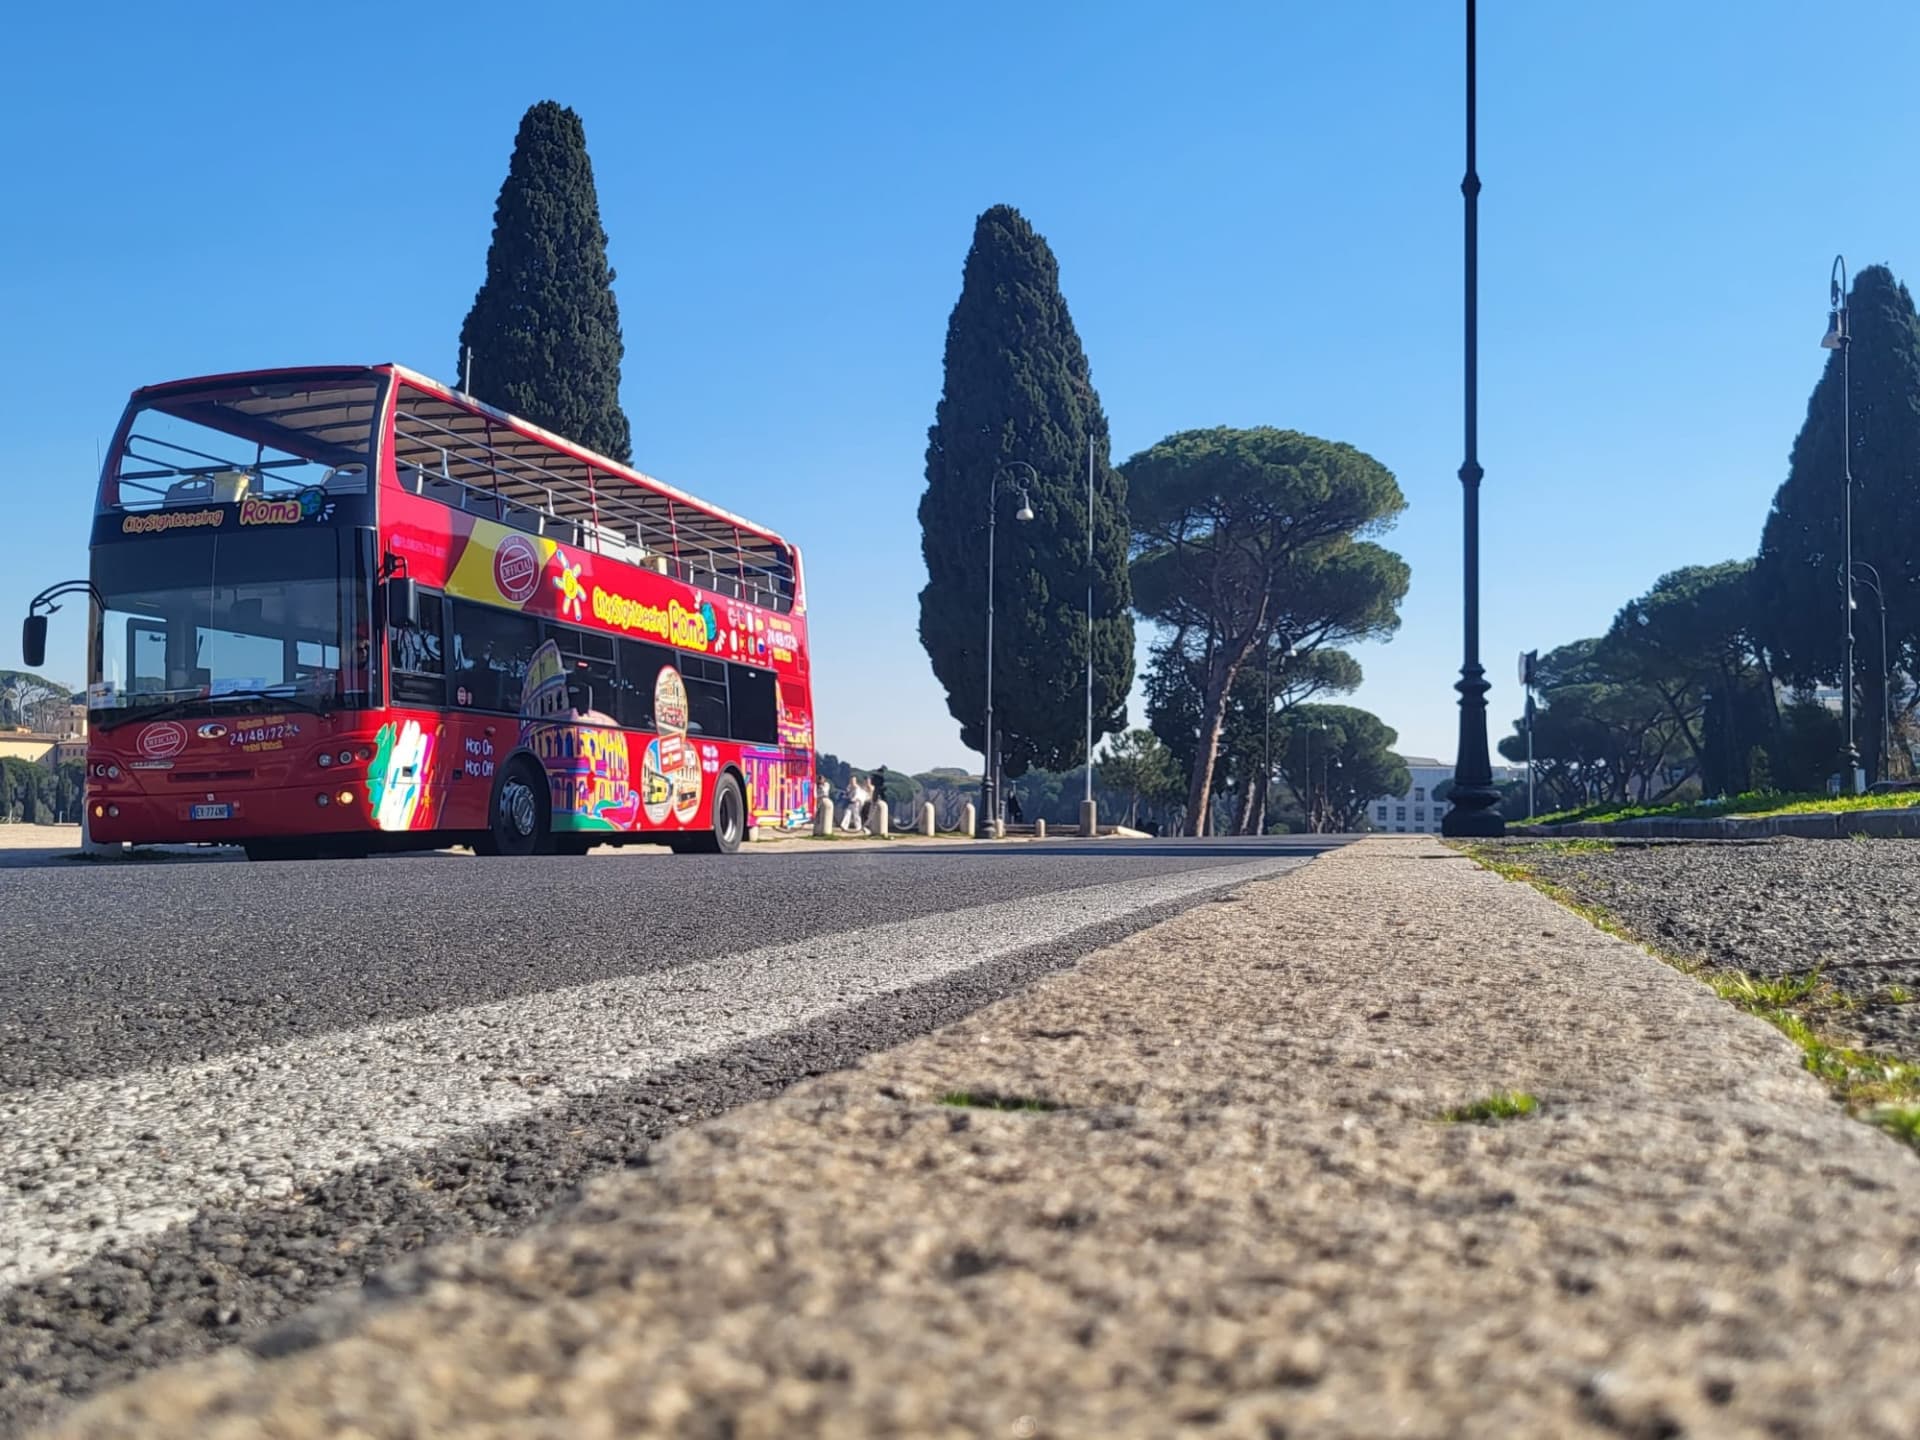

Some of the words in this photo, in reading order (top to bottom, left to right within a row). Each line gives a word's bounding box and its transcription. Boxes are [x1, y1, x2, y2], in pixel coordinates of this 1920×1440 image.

[240, 500, 301, 525] Roma
[669, 599, 708, 651] Roma
[466, 737, 481, 756] Hop
[482, 739, 493, 756] On
[465, 759, 481, 776] Hop
[482, 760, 494, 777] Off
